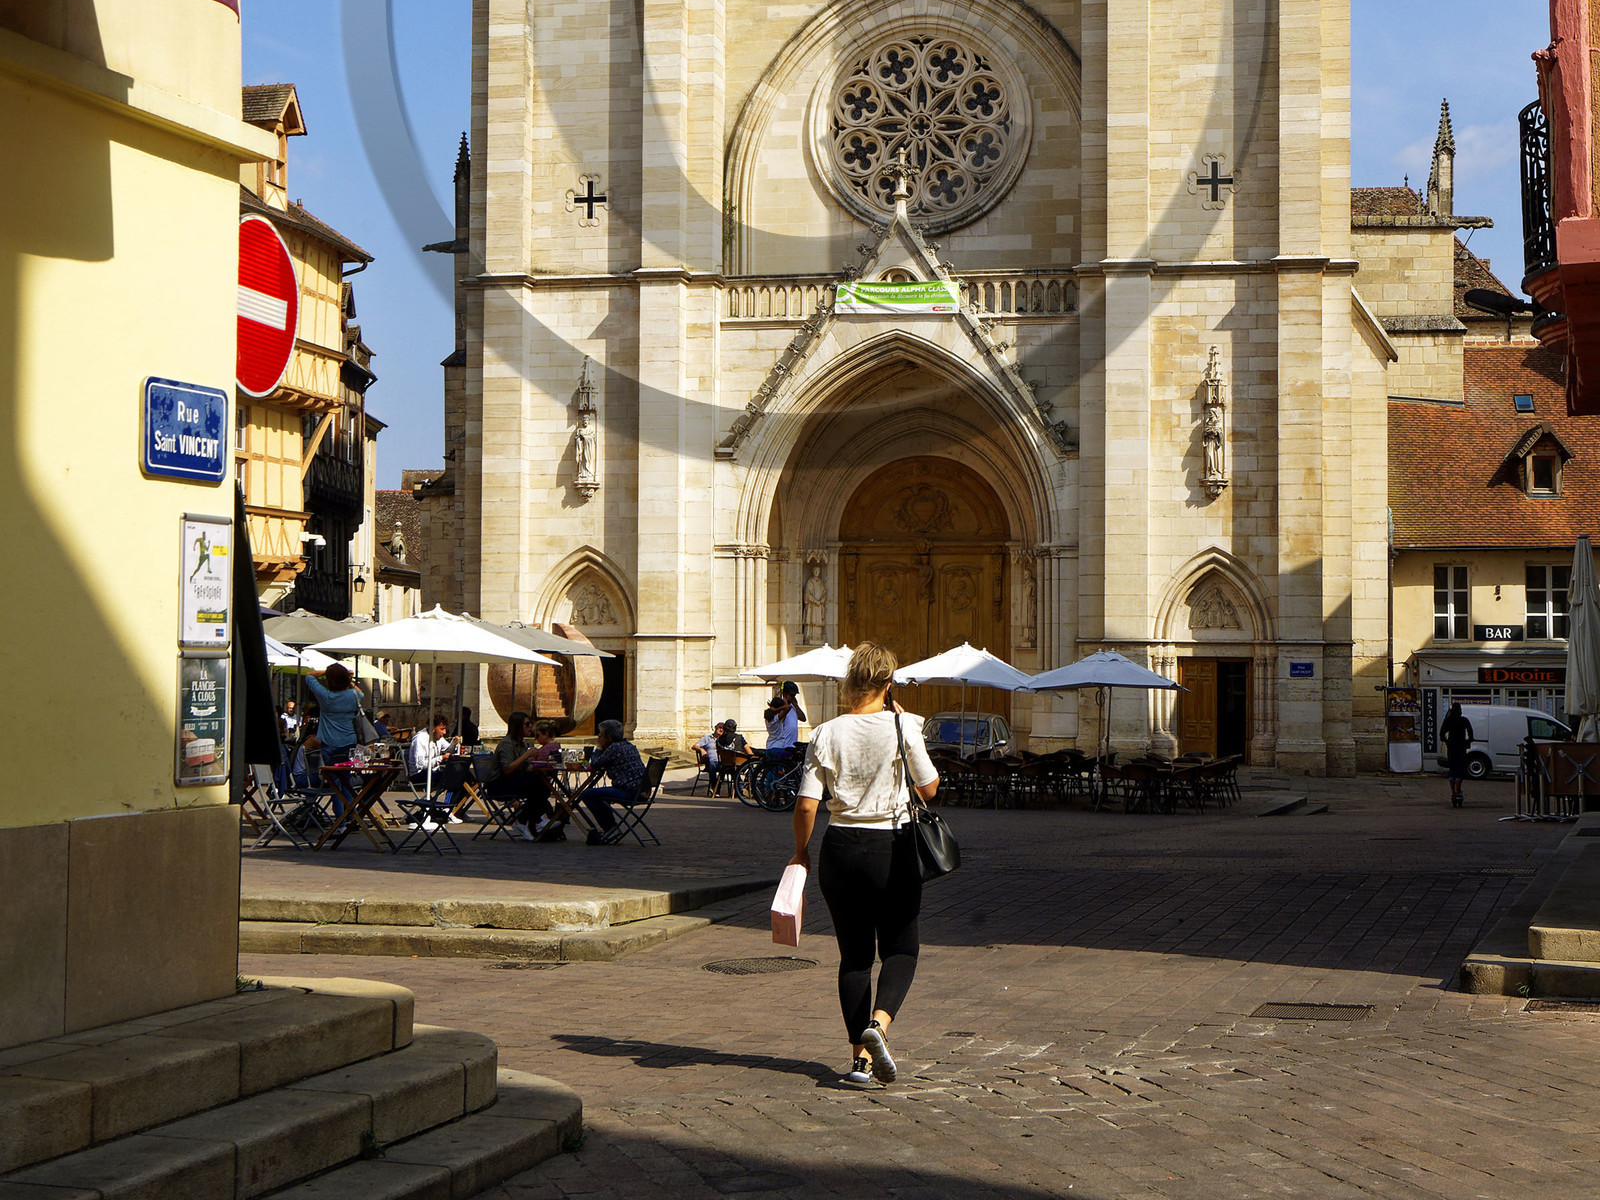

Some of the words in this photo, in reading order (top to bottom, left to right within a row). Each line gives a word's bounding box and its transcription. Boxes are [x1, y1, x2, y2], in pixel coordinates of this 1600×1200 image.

[177, 401, 199, 423] Rue
[154, 429, 177, 453] Saint
[179, 434, 219, 459] VINCENT
[1485, 628, 1512, 638] BAR
[200, 670, 208, 680] LA
[191, 680, 216, 691] PLANCHE
[198, 691, 216, 701] CLOUS
